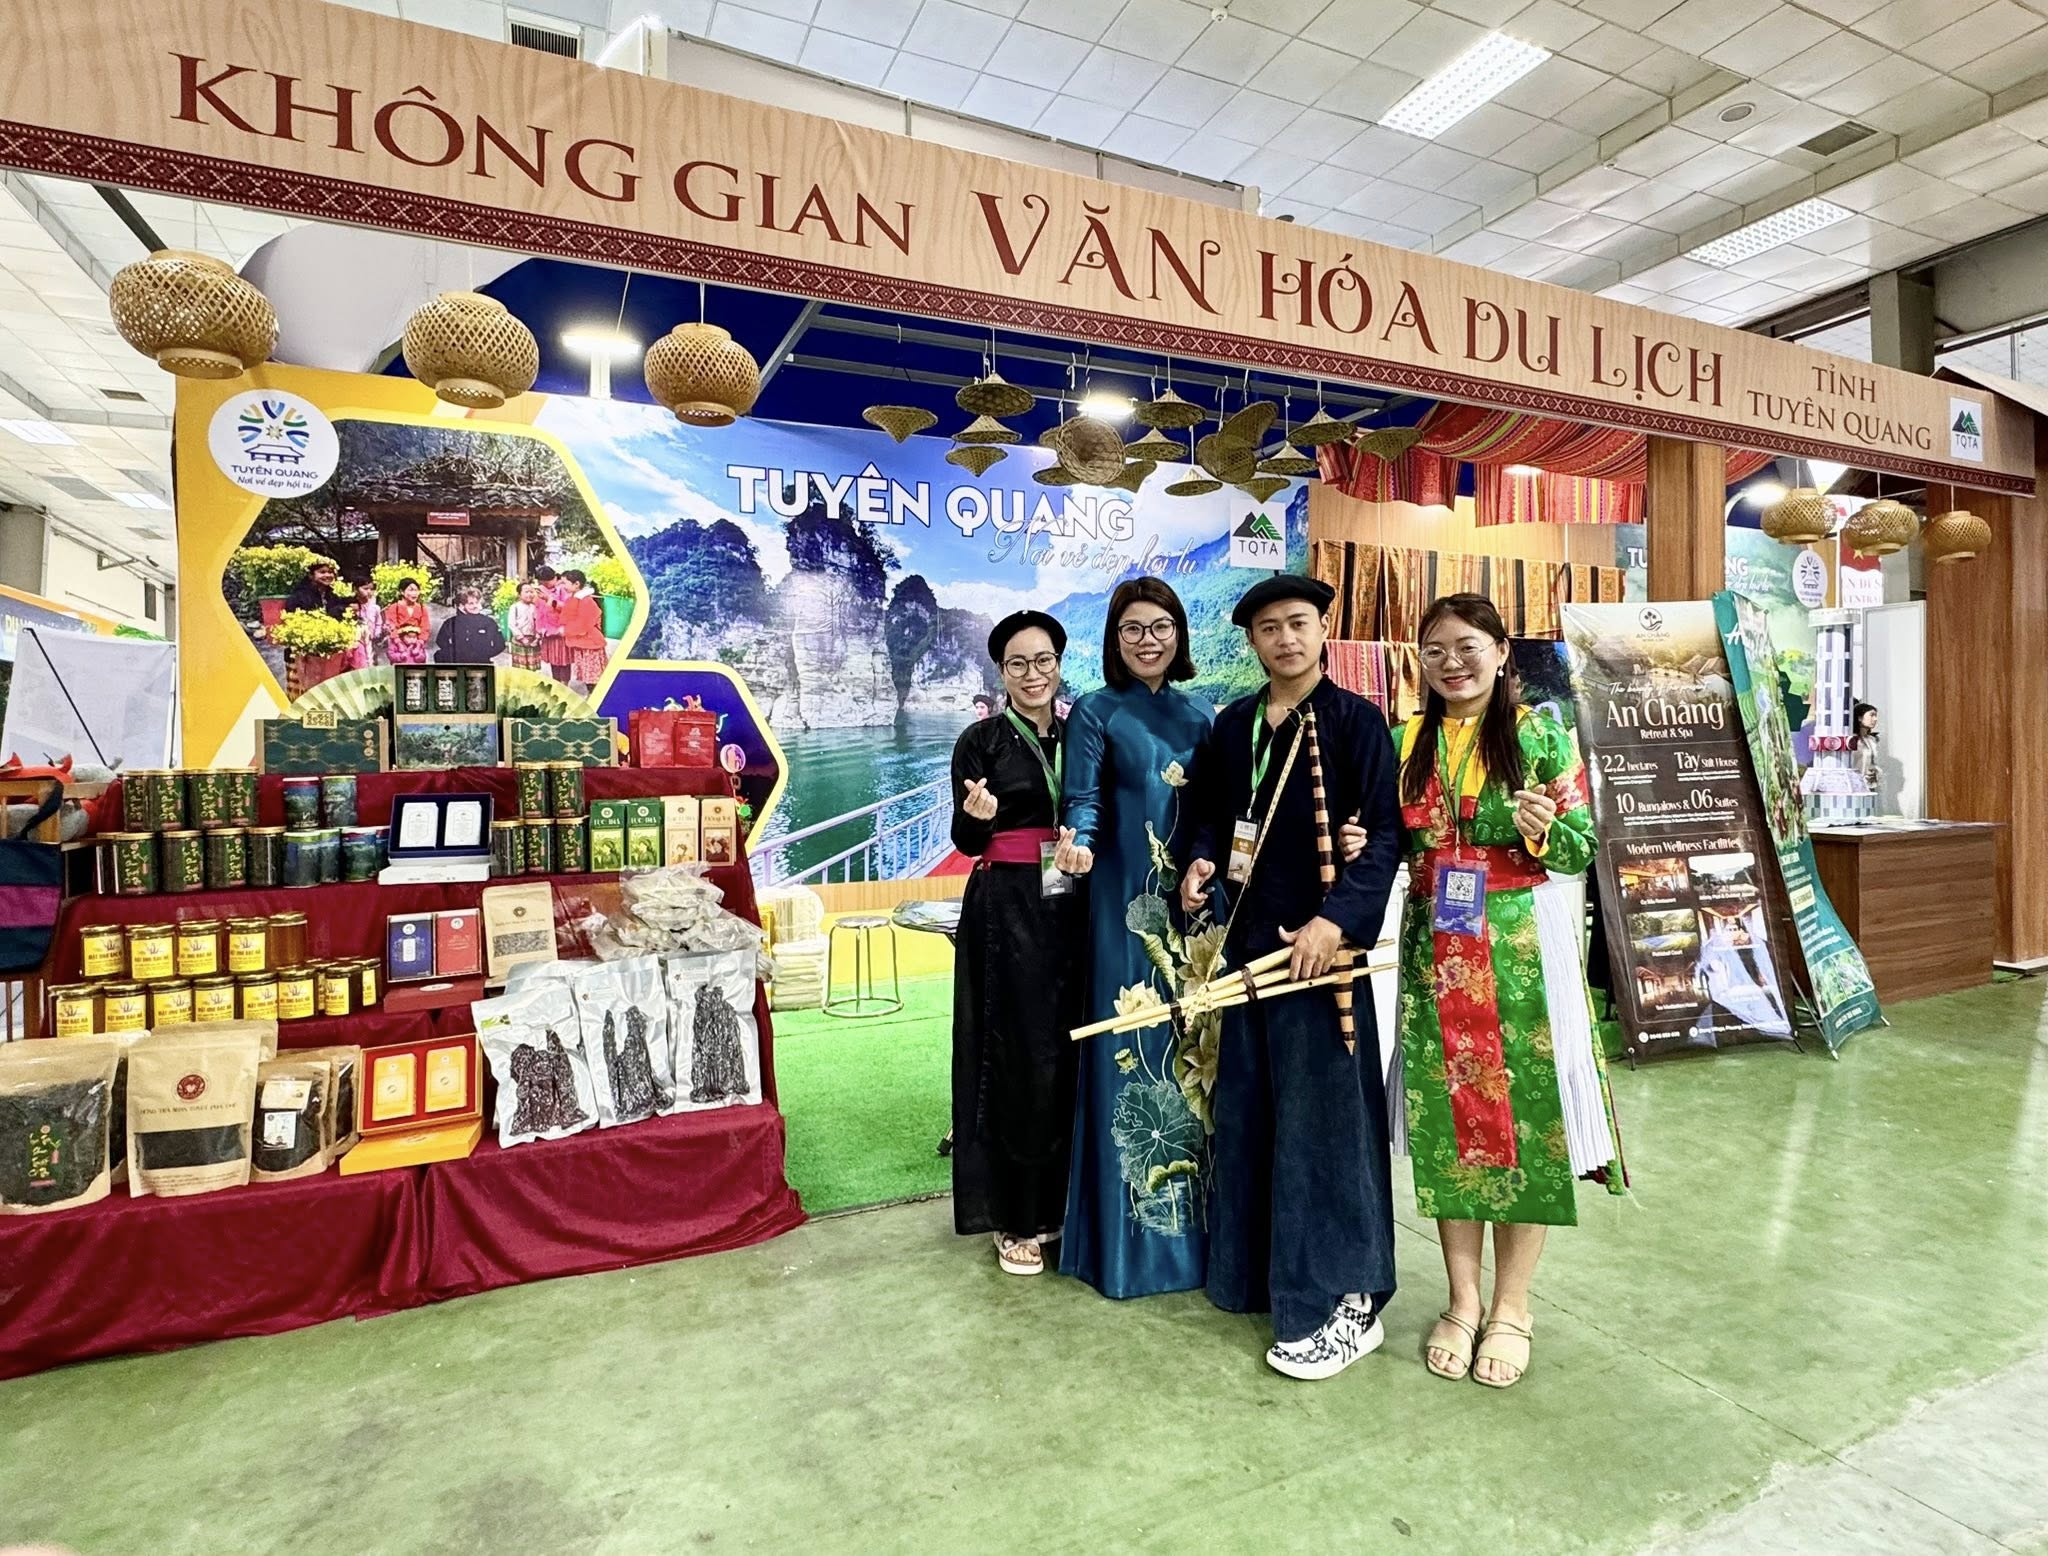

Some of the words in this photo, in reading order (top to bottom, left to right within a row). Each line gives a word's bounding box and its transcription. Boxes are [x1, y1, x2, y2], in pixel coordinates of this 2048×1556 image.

[170, 53, 640, 202] KHÔNG
[674, 160, 916, 257] GIAN
[970, 190, 1221, 315] VĂN
[1256, 253, 1441, 355] HÓA
[1463, 297, 1561, 377] DU
[1591, 326, 1723, 406] LỊCH
[1811, 363, 1876, 403] TỈNH
[1747, 390, 1835, 431] TUYÊN
[1843, 411, 1931, 450] QUANG
[1955, 433, 1979, 449] TQTA
[231, 465, 273, 476] TUYÊN
[275, 468, 319, 479] QUANG
[727, 462, 930, 527] TUYÊN
[945, 487, 1135, 541] QUANG
[1238, 539, 1279, 556] TQTA
[1606, 700, 1640, 728] An
[1640, 729, 1668, 739] Retreat
[1669, 728, 1677, 738] &
[1678, 727, 1694, 739] Spa
[1602, 754, 1626, 773] 2,2
[1627, 762, 1659, 771] hectares
[1674, 751, 1701, 771] Tày
[1715, 757, 1739, 767] House
[1616, 792, 1635, 814] 10
[1638, 801, 1682, 814] Bungalows
[1683, 800, 1690, 810] &
[1691, 788, 1713, 809] 06
[1714, 797, 1739, 808] Suites
[1626, 843, 1662, 855] Modern
[1662, 840, 1702, 853] Wellness
[1702, 838, 1742, 850] Facilities
